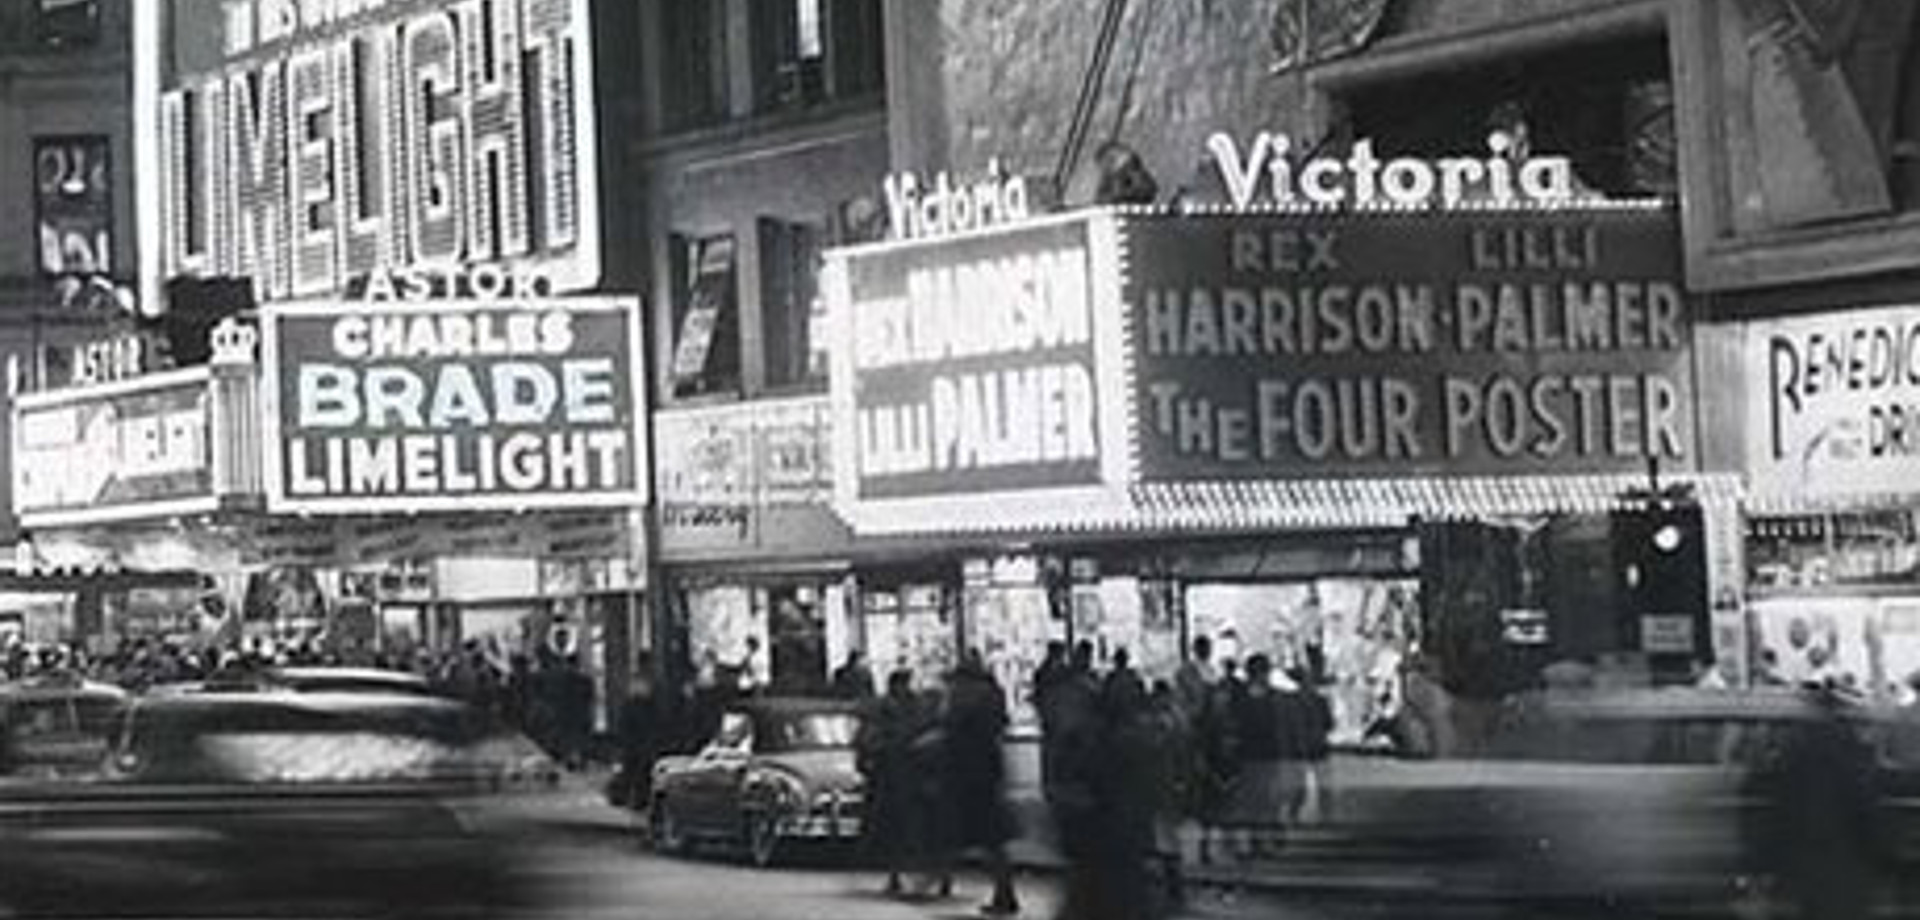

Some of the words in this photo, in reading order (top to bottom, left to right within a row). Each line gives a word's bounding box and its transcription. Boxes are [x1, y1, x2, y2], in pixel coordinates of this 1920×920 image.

[160, 0, 580, 304] LIMELIGHT
[1207, 130, 1573, 208] Victoria
[885, 157, 1028, 239] Victoria
[1232, 230, 1340, 270] REX
[1472, 228, 1599, 270] LILLI
[332, 310, 575, 358] CHARLES
[298, 357, 615, 429] BRADE
[930, 362, 1098, 471] PALMER
[1257, 375, 1423, 461] FOUR
[1445, 371, 1684, 462] POSTER
[289, 431, 627, 496] LIMELIGHT
